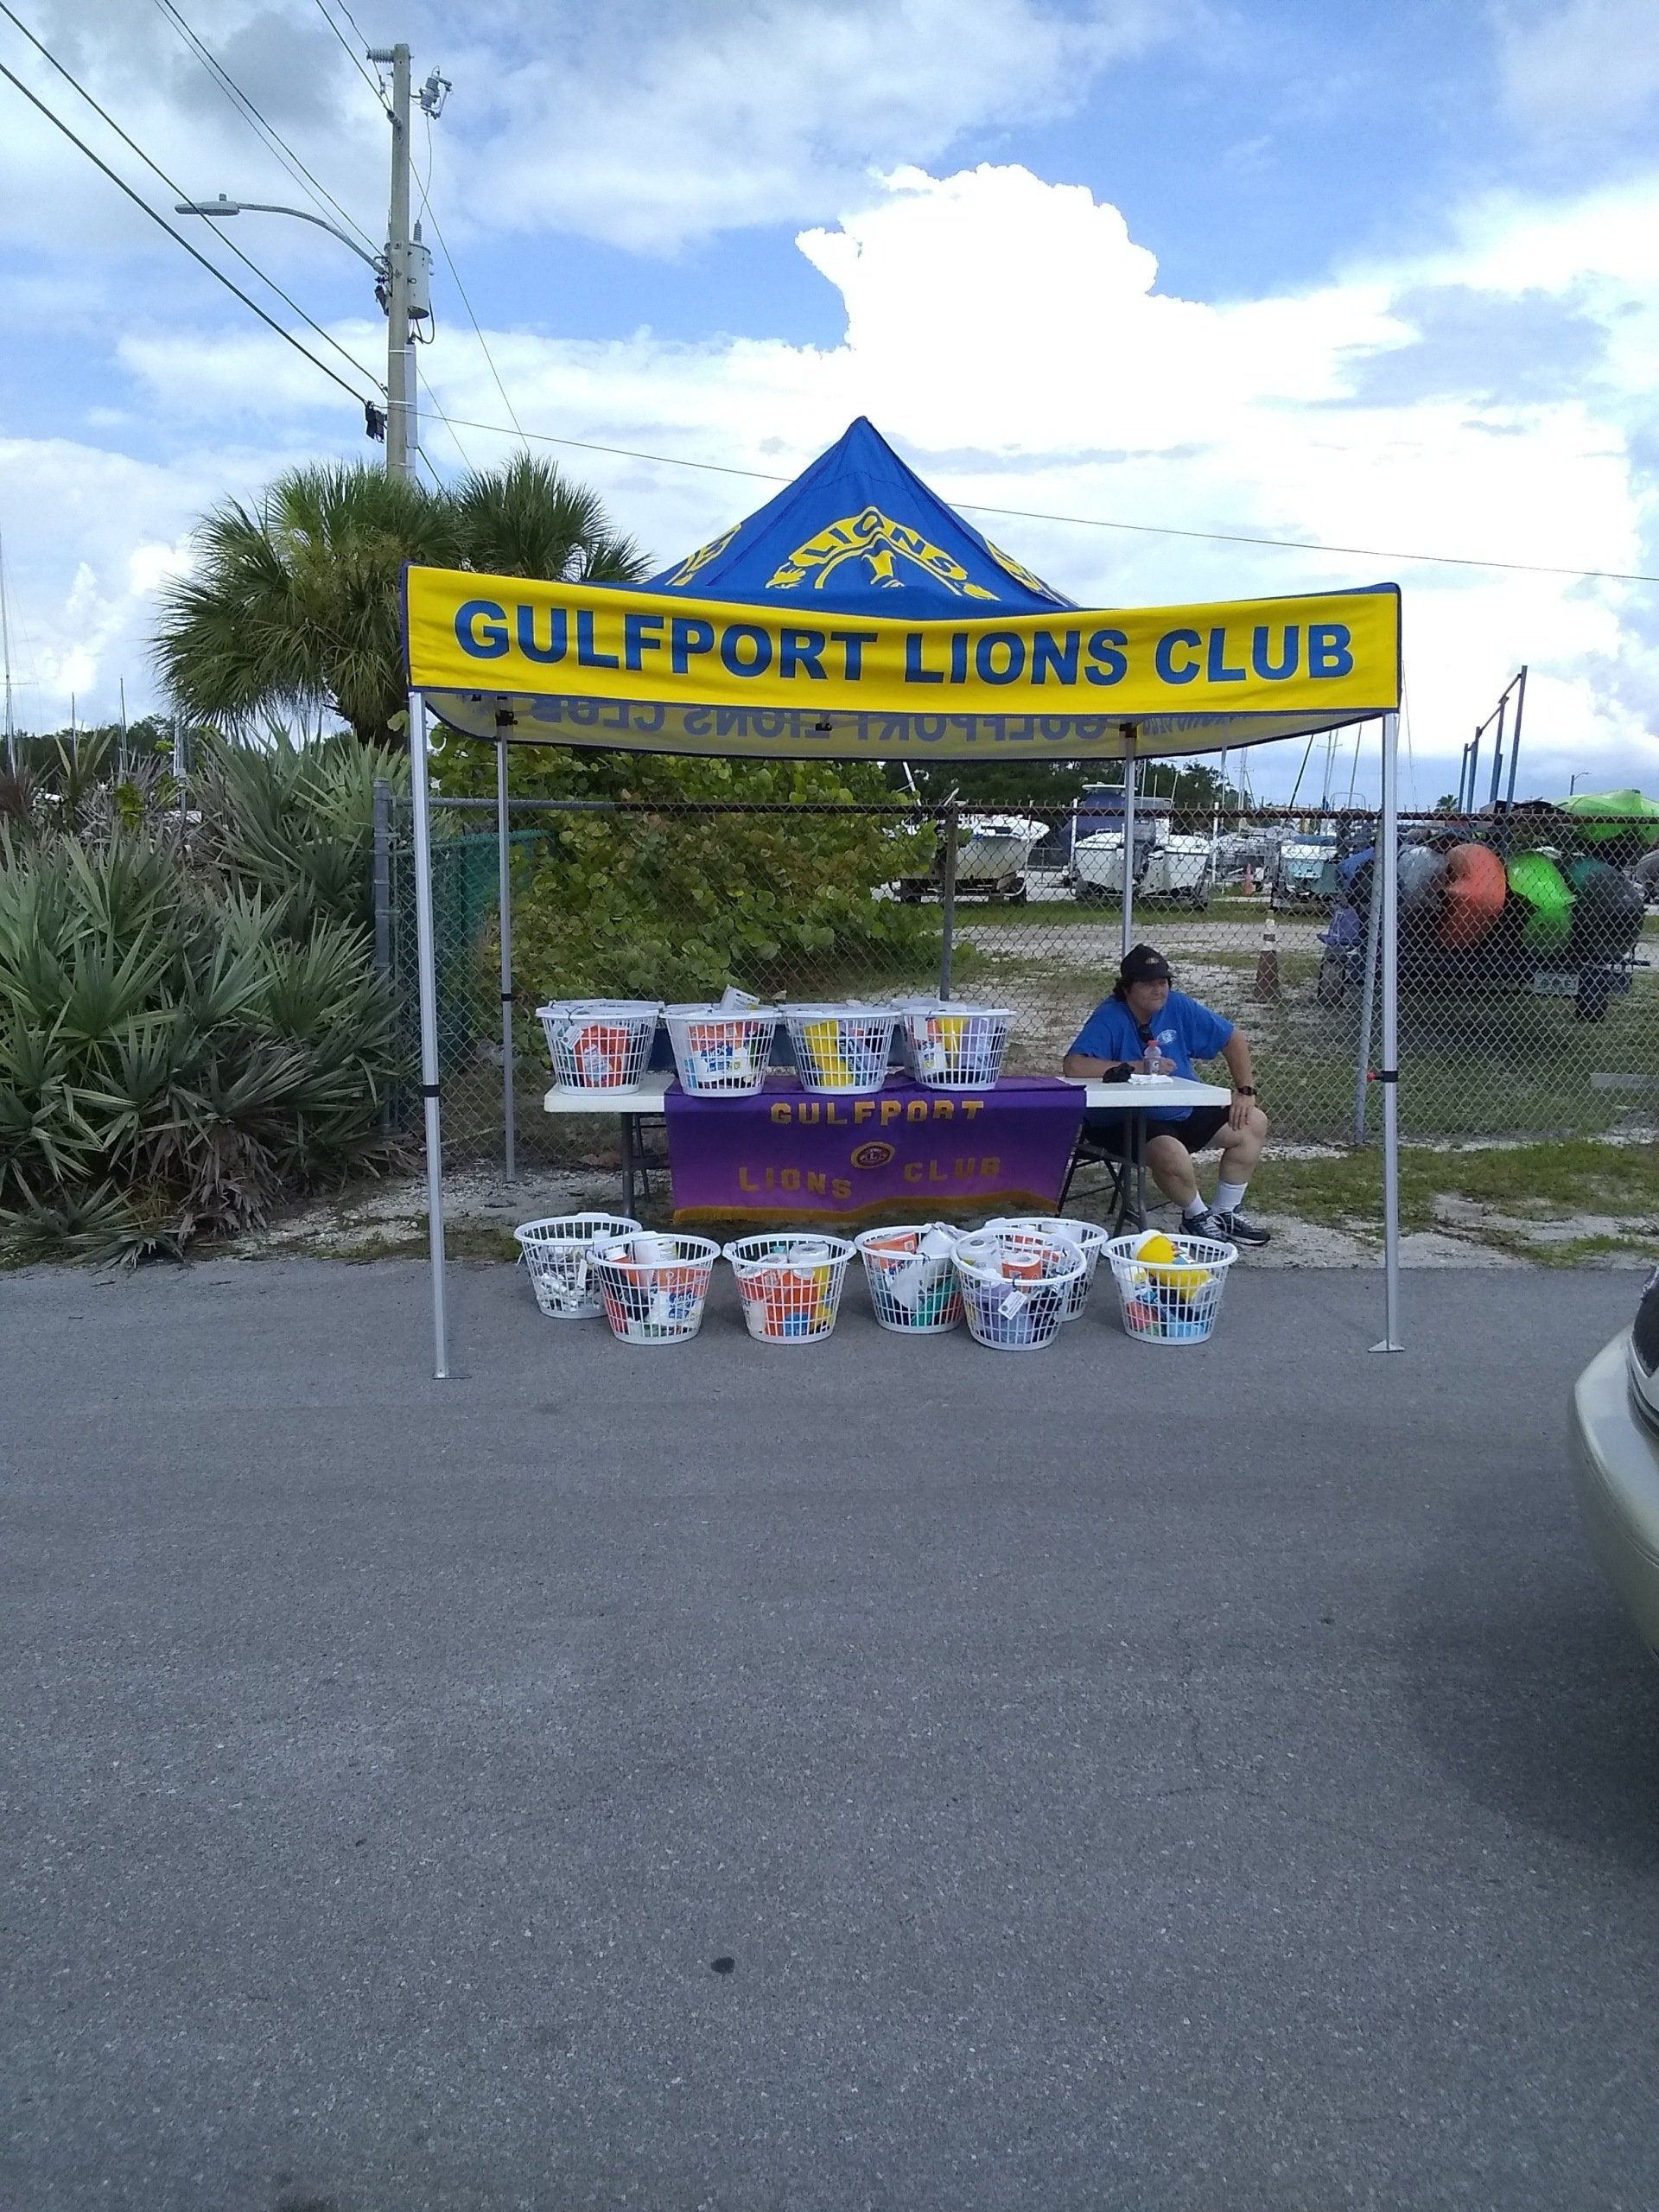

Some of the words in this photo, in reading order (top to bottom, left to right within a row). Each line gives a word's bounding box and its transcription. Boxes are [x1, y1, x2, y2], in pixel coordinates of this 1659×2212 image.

[801, 510, 958, 574] LIONS
[454, 599, 879, 682] GULFPORT
[904, 629, 1129, 686] LIONS
[1154, 623, 1354, 686] CLUB
[771, 1099, 985, 1126] GULFPORT
[739, 1166, 852, 1199] LIONS
[904, 1157, 1001, 1183] CLUB
